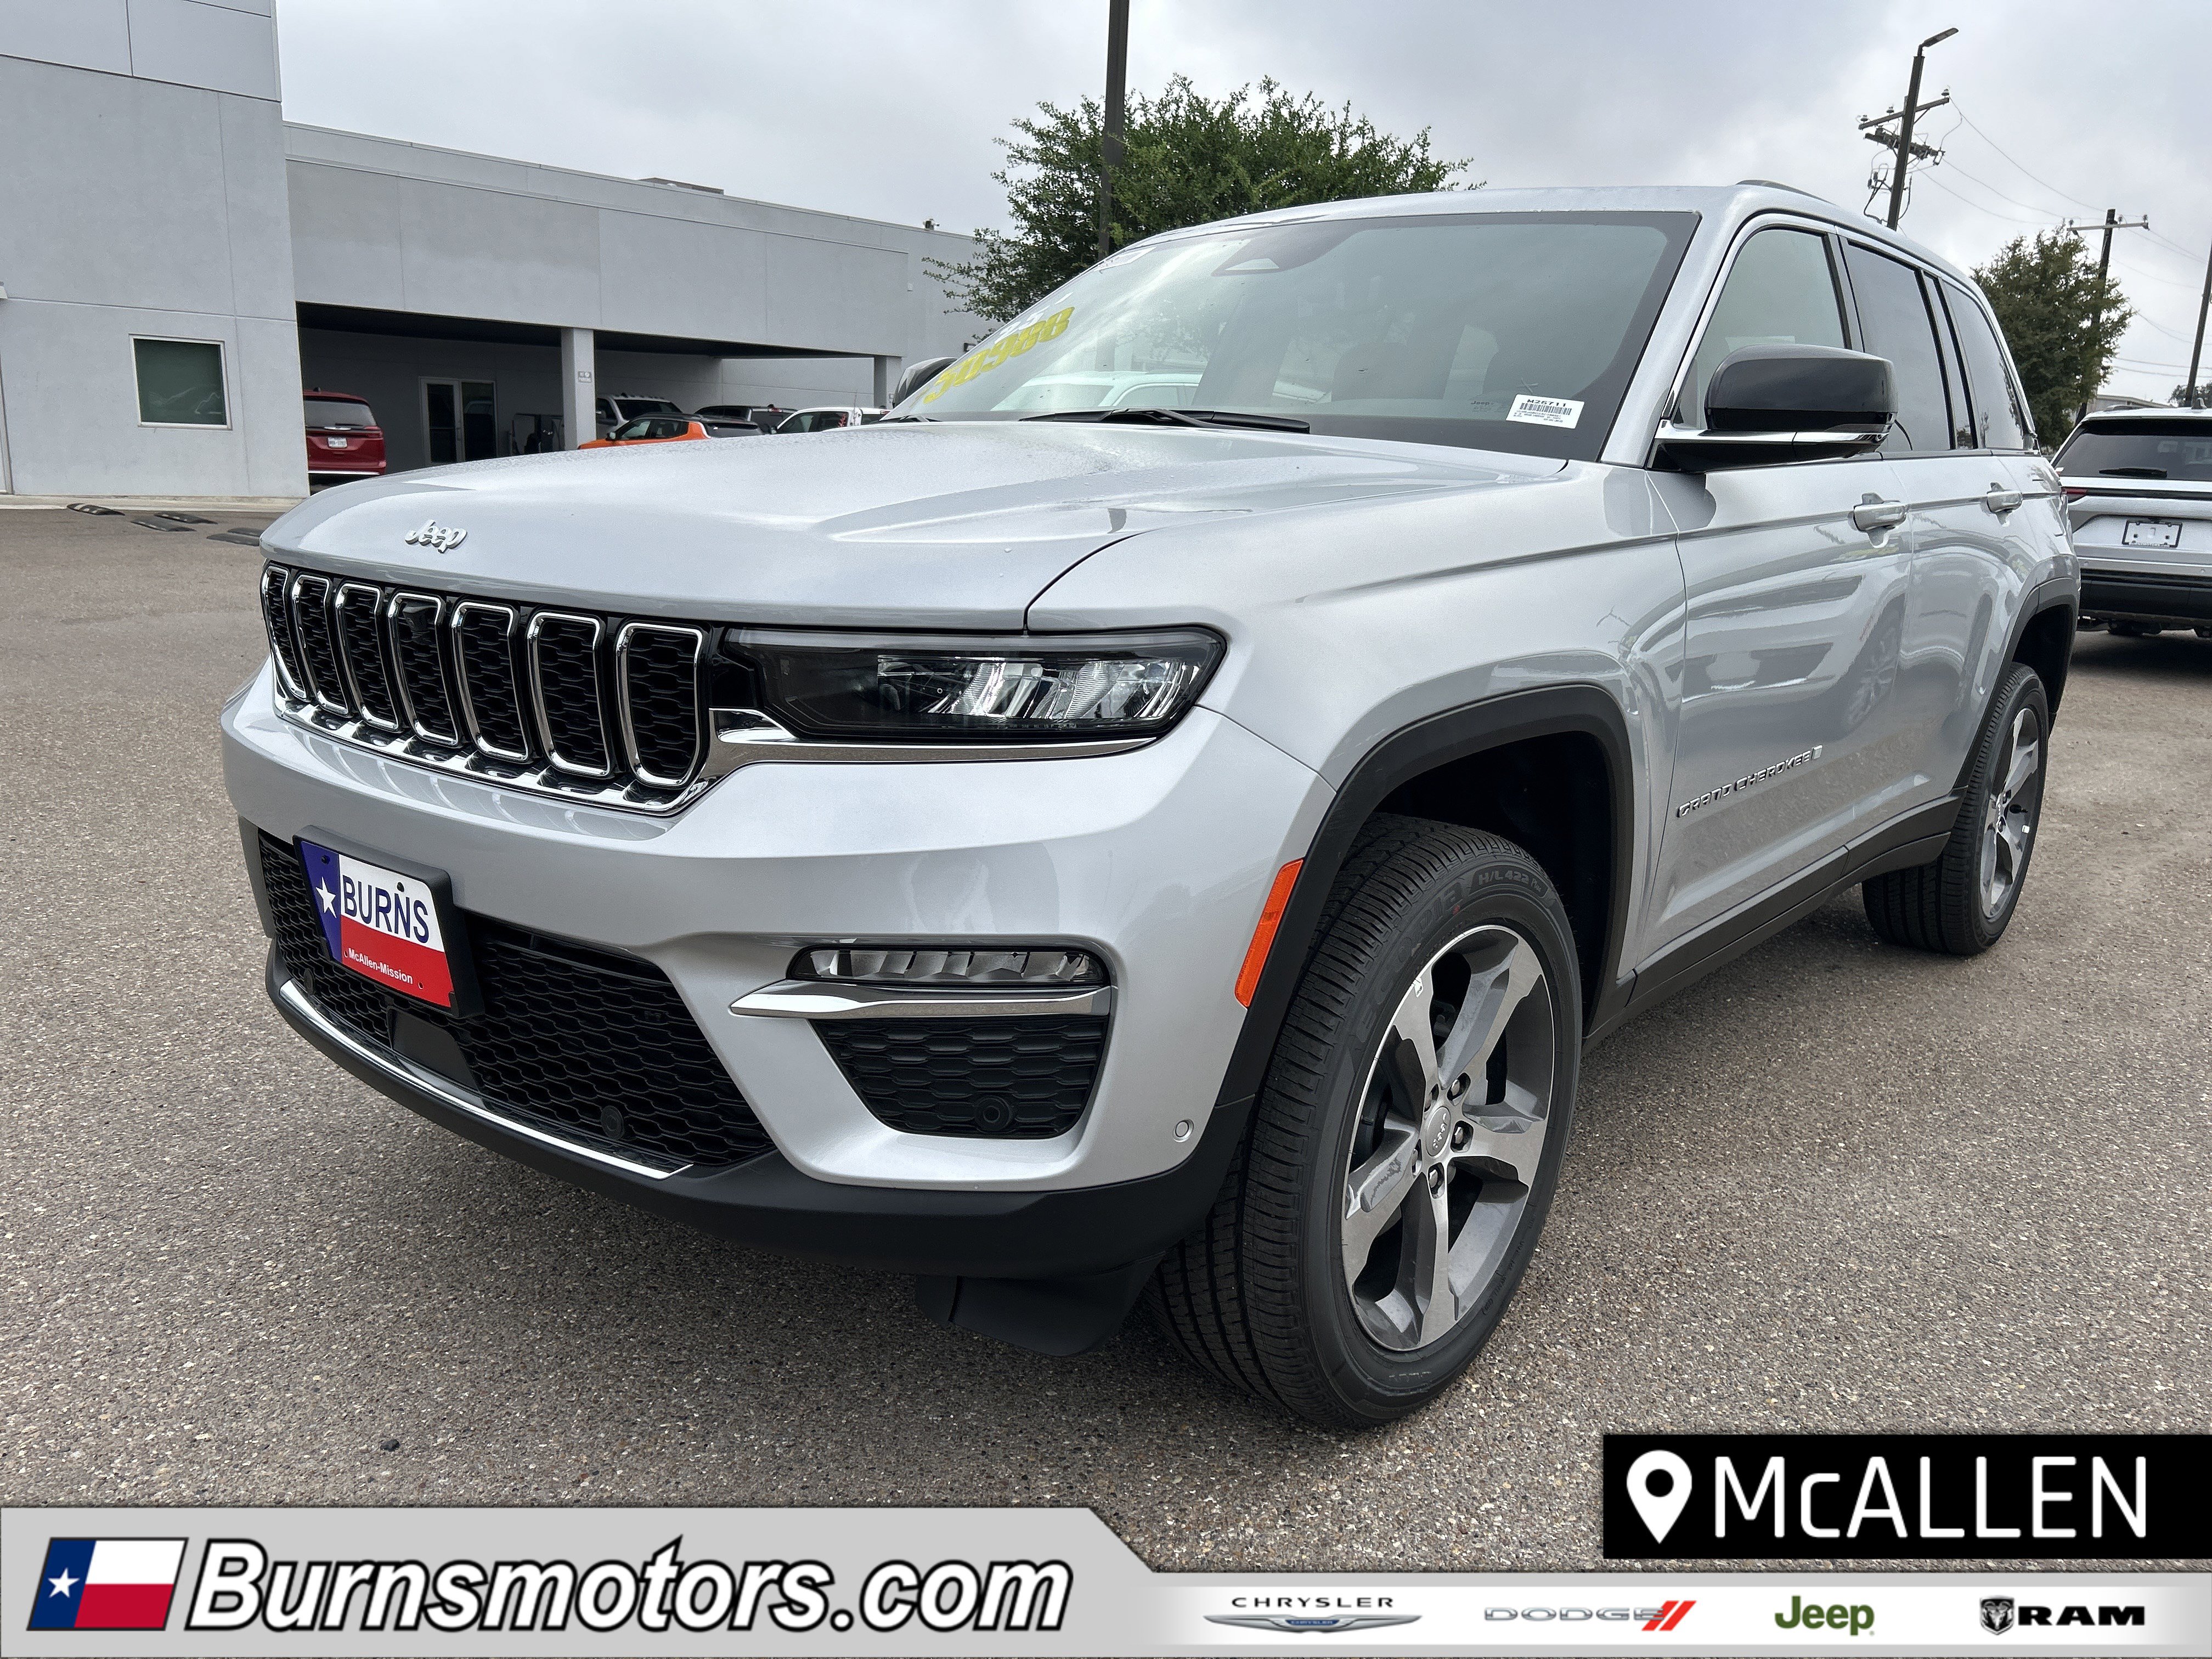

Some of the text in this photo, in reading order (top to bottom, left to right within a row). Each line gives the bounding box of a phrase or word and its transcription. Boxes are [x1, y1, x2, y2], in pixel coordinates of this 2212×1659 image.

[405, 519, 468, 554] Jeep
[1676, 750, 1812, 818] GRAND CHEROKEE
[342, 874, 430, 944] BURNS
[347, 947, 414, 985] McAllen-Mission
